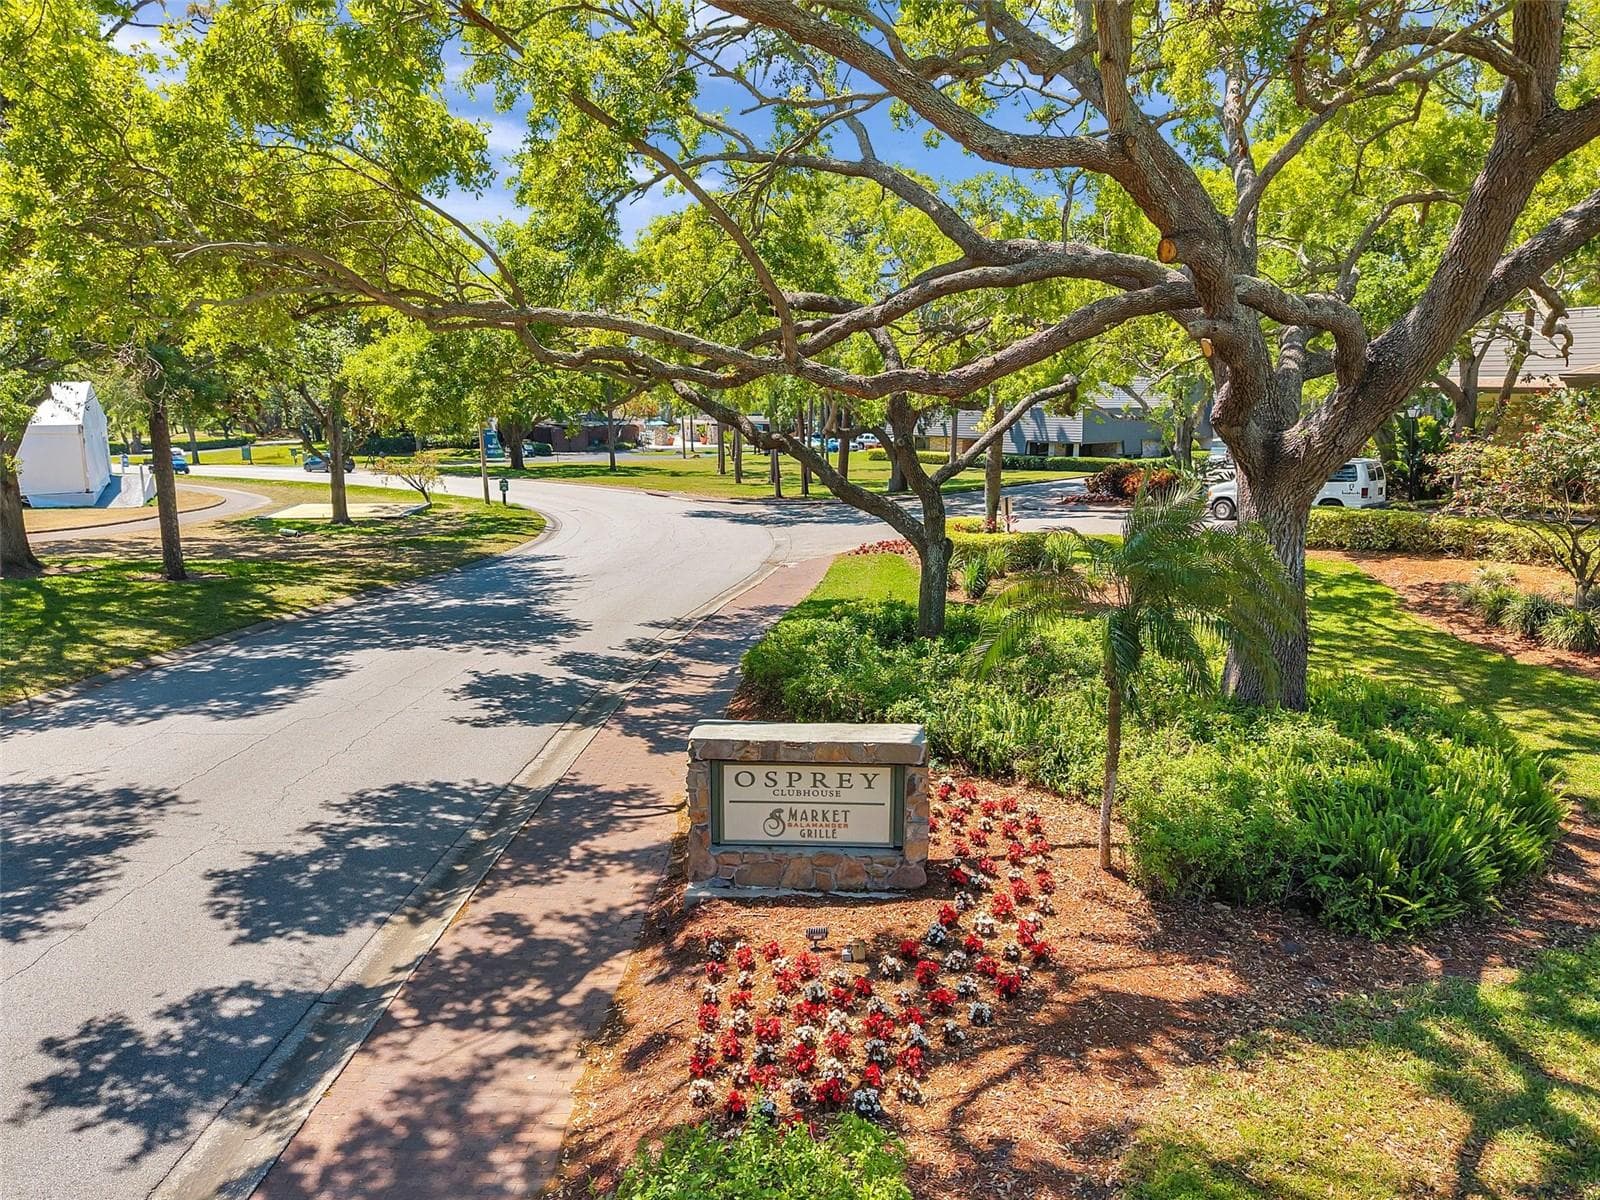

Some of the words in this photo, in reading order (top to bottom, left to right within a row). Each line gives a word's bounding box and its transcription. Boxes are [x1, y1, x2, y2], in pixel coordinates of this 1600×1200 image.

[734, 770, 880, 789] OSPREY
[772, 789, 841, 798] CLUBHOUSE
[787, 807, 850, 823] MARKET
